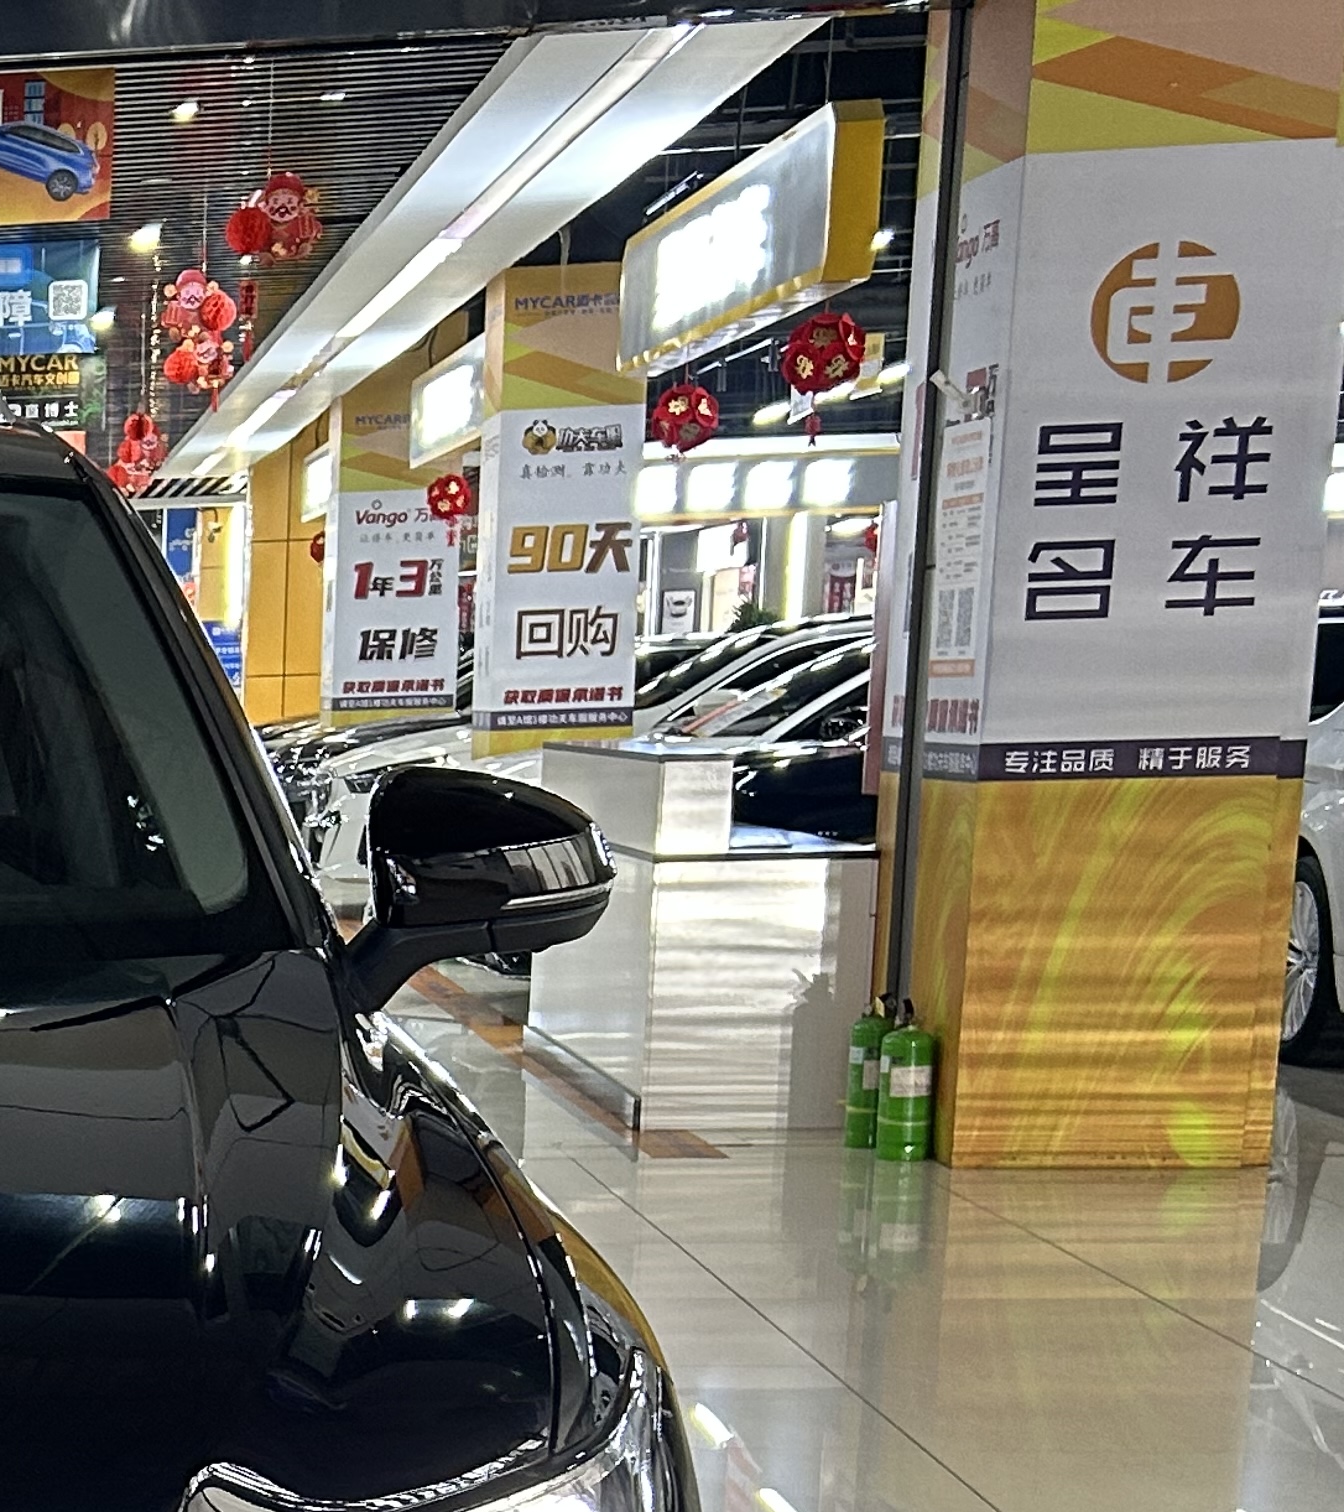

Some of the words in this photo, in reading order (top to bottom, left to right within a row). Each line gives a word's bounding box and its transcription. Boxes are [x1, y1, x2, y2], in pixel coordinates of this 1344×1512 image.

[355, 509, 408, 528] Vango
[507, 521, 633, 574] 90天
[358, 627, 439, 662] 保修
[515, 605, 620, 660] 回购
[1004, 747, 1115, 774] 专注品质
[1137, 744, 1252, 771] 精于服务
